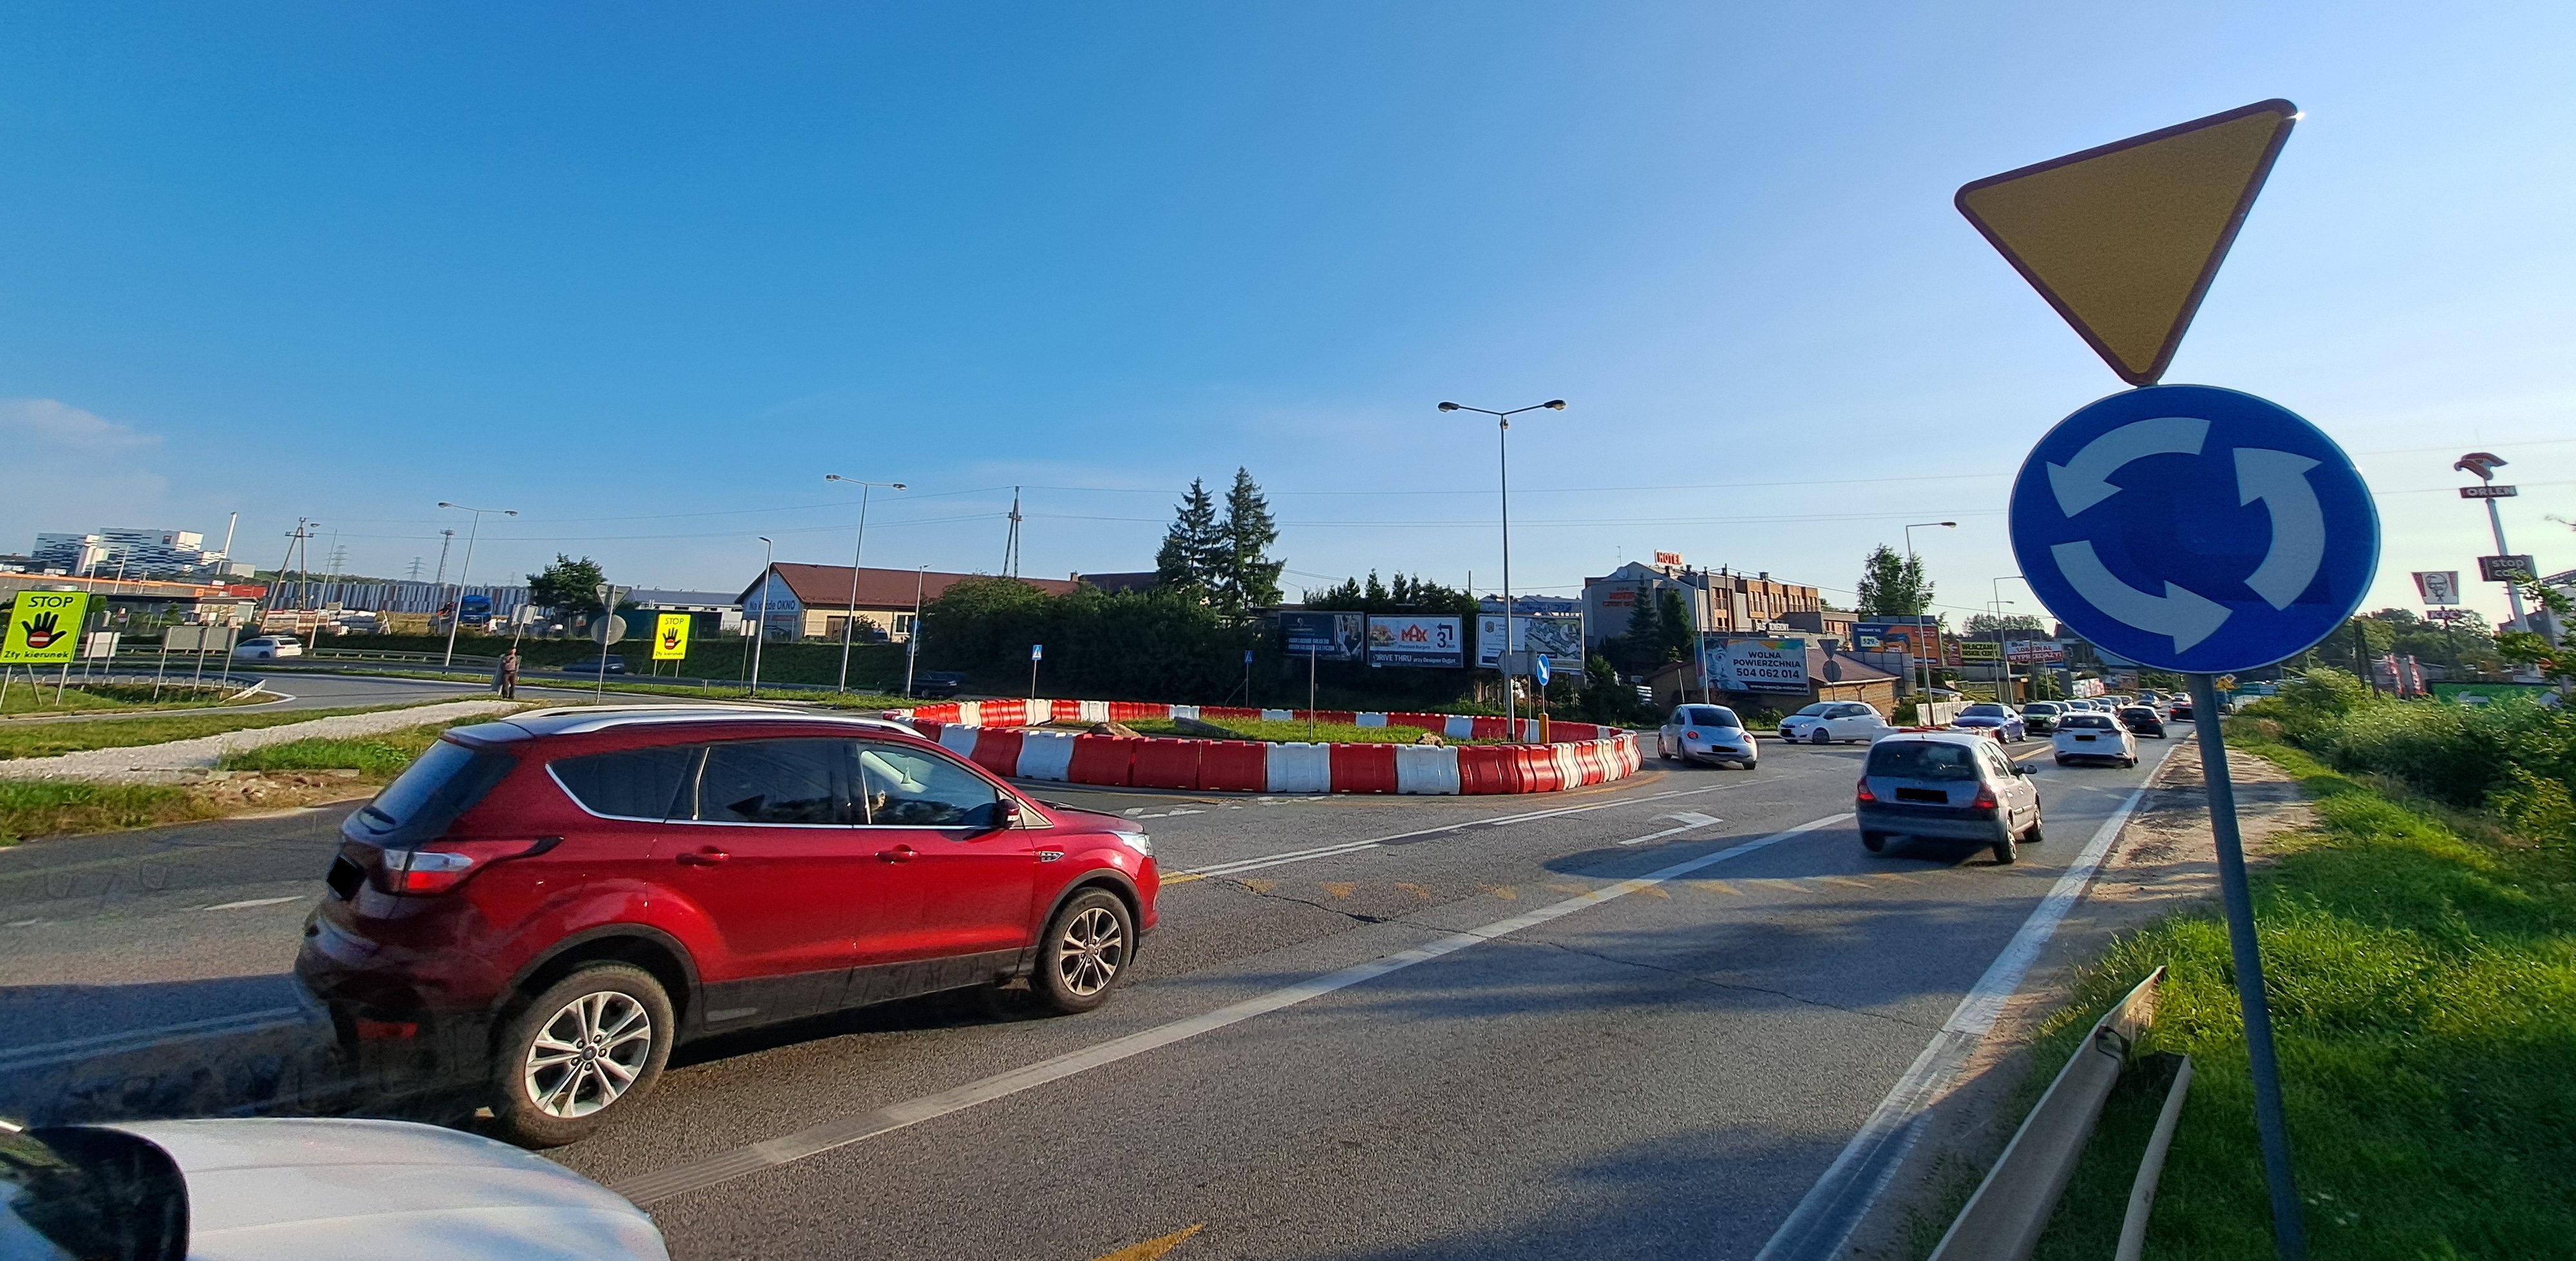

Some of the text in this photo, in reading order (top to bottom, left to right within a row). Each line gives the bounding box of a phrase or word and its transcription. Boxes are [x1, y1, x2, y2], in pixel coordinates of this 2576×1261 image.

[2467, 487, 2516, 496] ORLEN
[1657, 552, 1682, 565] HOTEL
[2492, 559, 2525, 569] stop
[28, 596, 73, 607] STOP
[749, 600, 796, 611] Na kżde OKNO
[1401, 624, 1428, 641] MAX
[1437, 631, 1446, 648] 3
[4, 650, 21, 659] Zły
[1394, 654, 1412, 662] THRU
[1733, 659, 1801, 667] POWIERZCHNIA
[1736, 668, 1800, 678] 504 062 014
